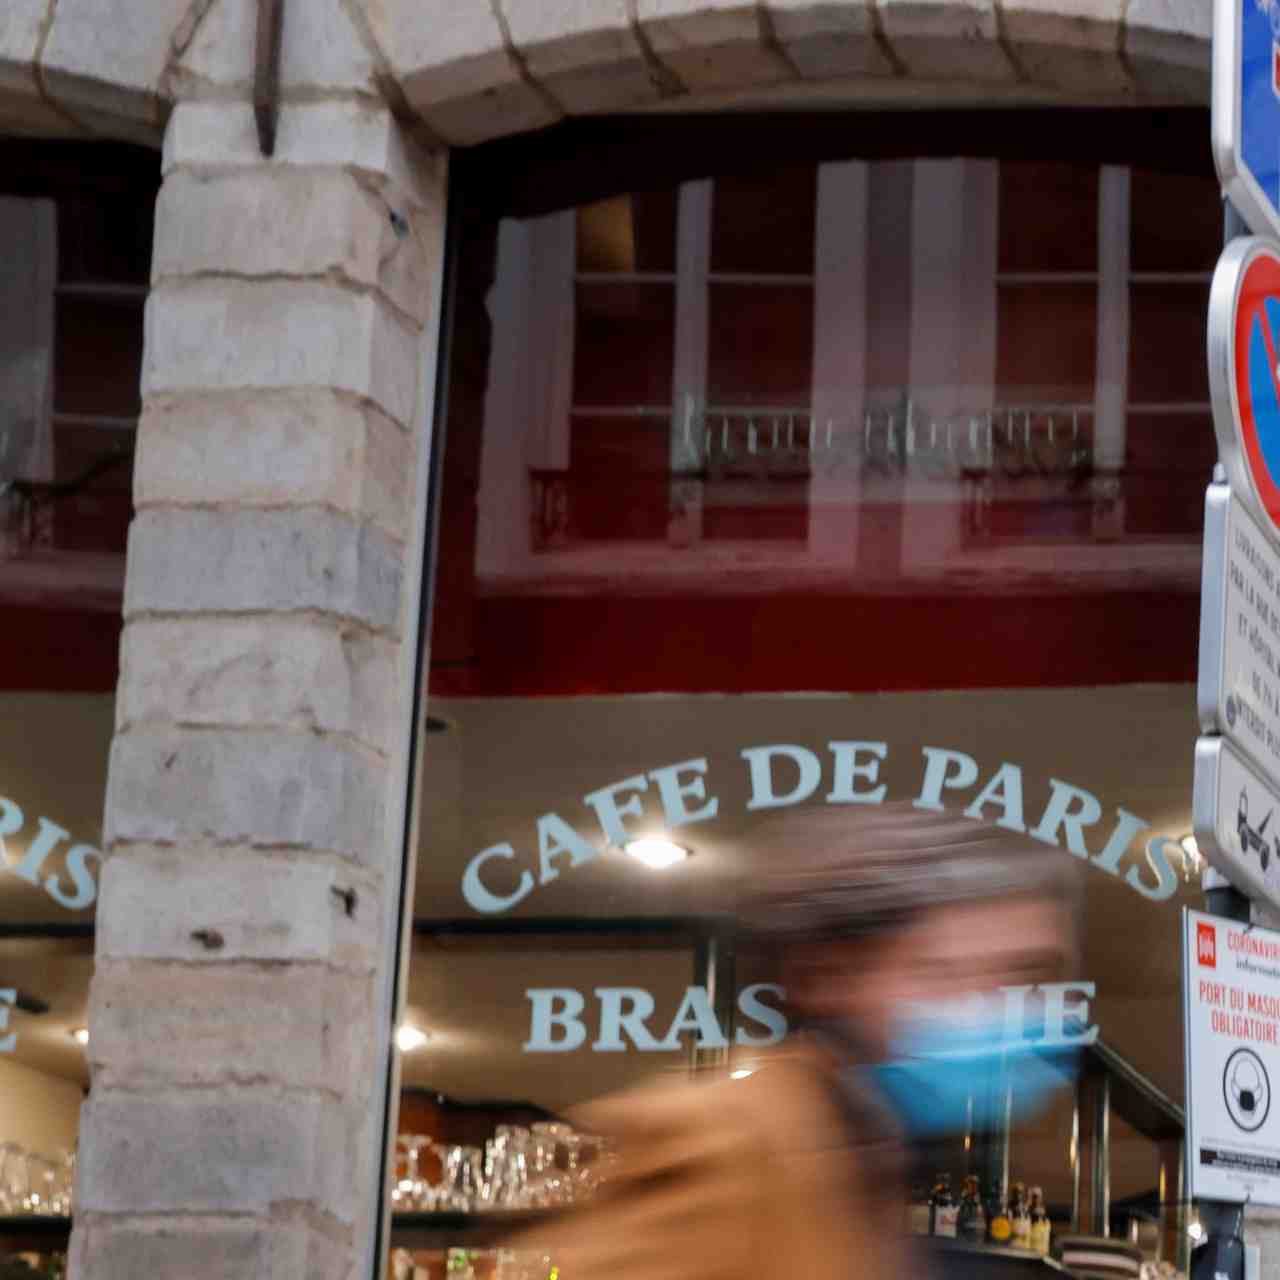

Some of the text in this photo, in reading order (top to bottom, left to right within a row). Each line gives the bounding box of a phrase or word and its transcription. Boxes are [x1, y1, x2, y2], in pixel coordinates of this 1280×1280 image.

[461, 741, 1182, 914] CAFE DE PARIS
[522, 981, 1101, 1053] BRASIE
[1200, 980, 1226, 1008] PORT
[1230, 987, 1245, 1012] DU
[1211, 1008, 1278, 1045] OBLIGATOIRE
